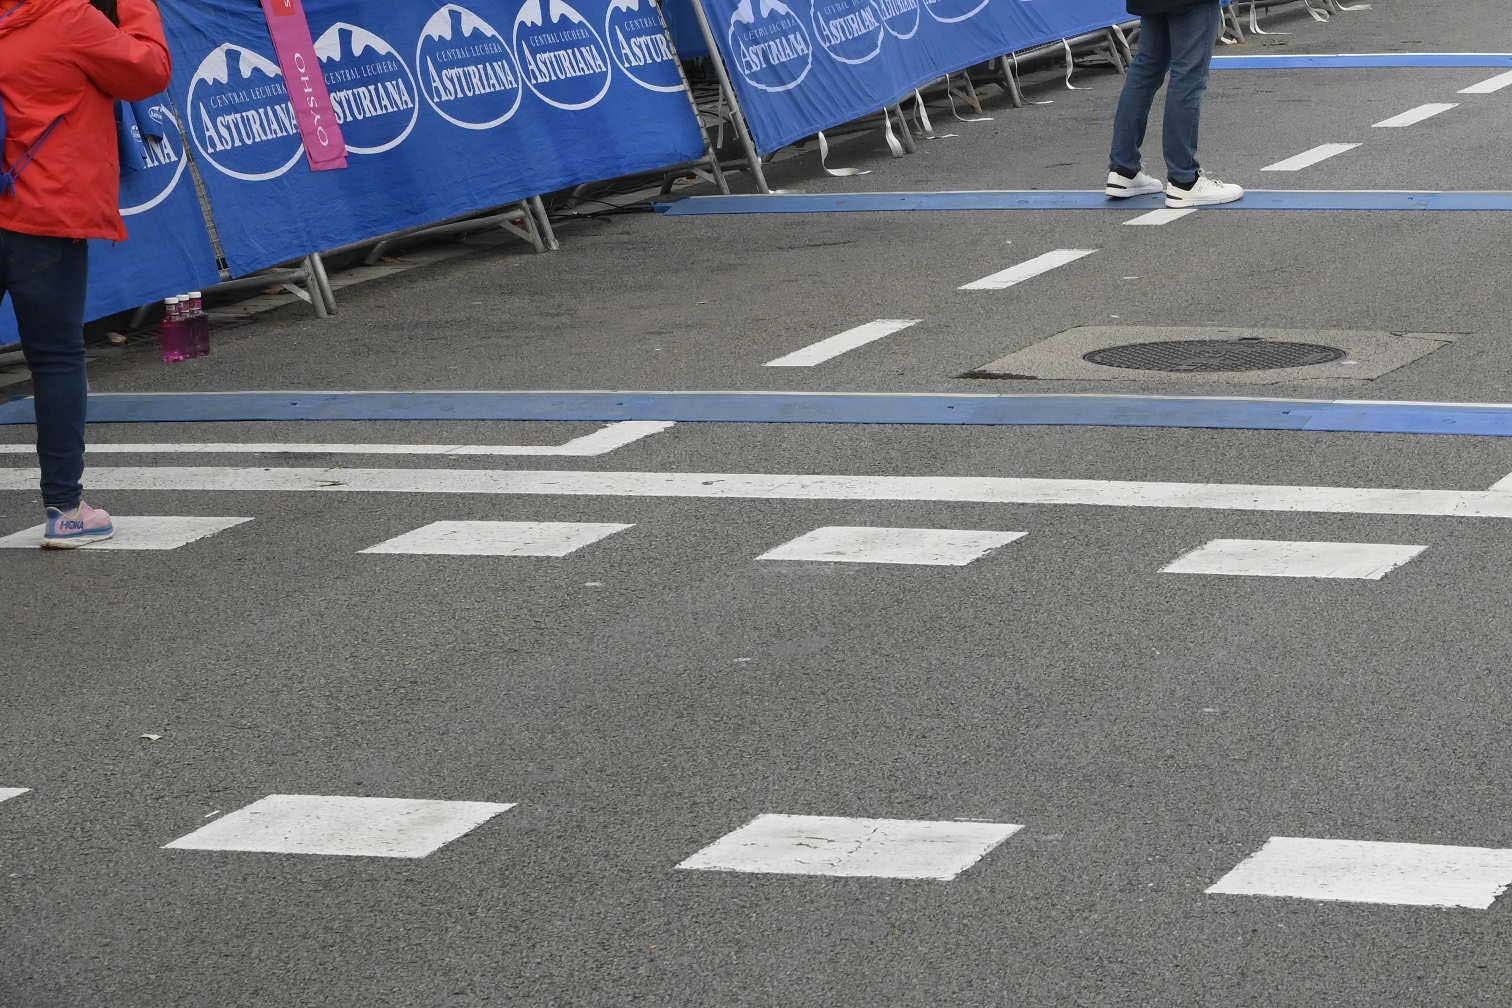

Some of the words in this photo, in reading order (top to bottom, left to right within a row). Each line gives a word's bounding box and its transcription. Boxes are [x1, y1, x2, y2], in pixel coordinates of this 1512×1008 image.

[436, 46, 470, 61] CENTRAL
[471, 42, 503, 58] LECHERA
[530, 32, 559, 47] CENTRAL
[560, 29, 590, 43] LECHERA
[325, 70, 361, 85] CENTRAL
[362, 62, 398, 77] LECHERA
[427, 55, 518, 103] ASTURIANA
[522, 40, 607, 84] ASTURIANA
[210, 93, 250, 109] CENTRAL
[294, 52, 329, 146] OYSHO
[330, 78, 414, 124] STURIANA
[199, 101, 300, 154] ASTURIANA
